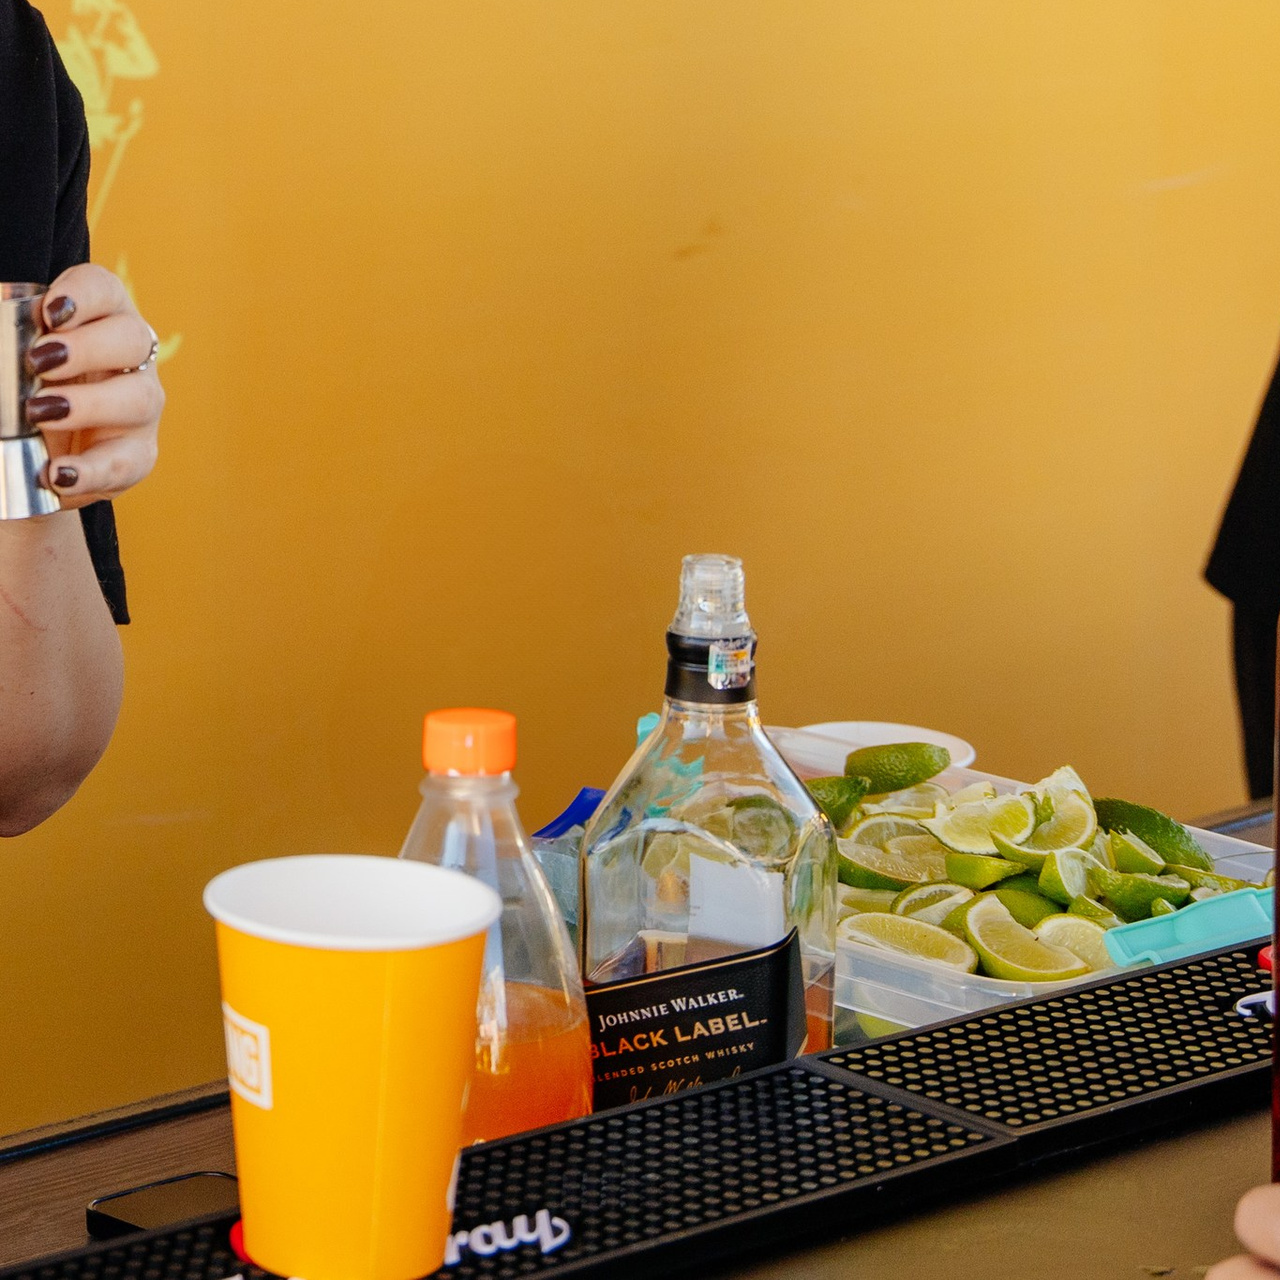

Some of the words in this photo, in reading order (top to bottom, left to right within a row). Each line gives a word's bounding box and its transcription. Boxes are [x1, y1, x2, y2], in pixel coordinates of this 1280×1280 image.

[598, 1002, 670, 1032] JOHNNIE
[671, 989, 740, 1013] WALKER
[674, 1011, 761, 1043] LABEL
[593, 1065, 645, 1083] LENDED
[650, 1053, 700, 1071] SCOTCH
[705, 1041, 755, 1060] WHISKY
